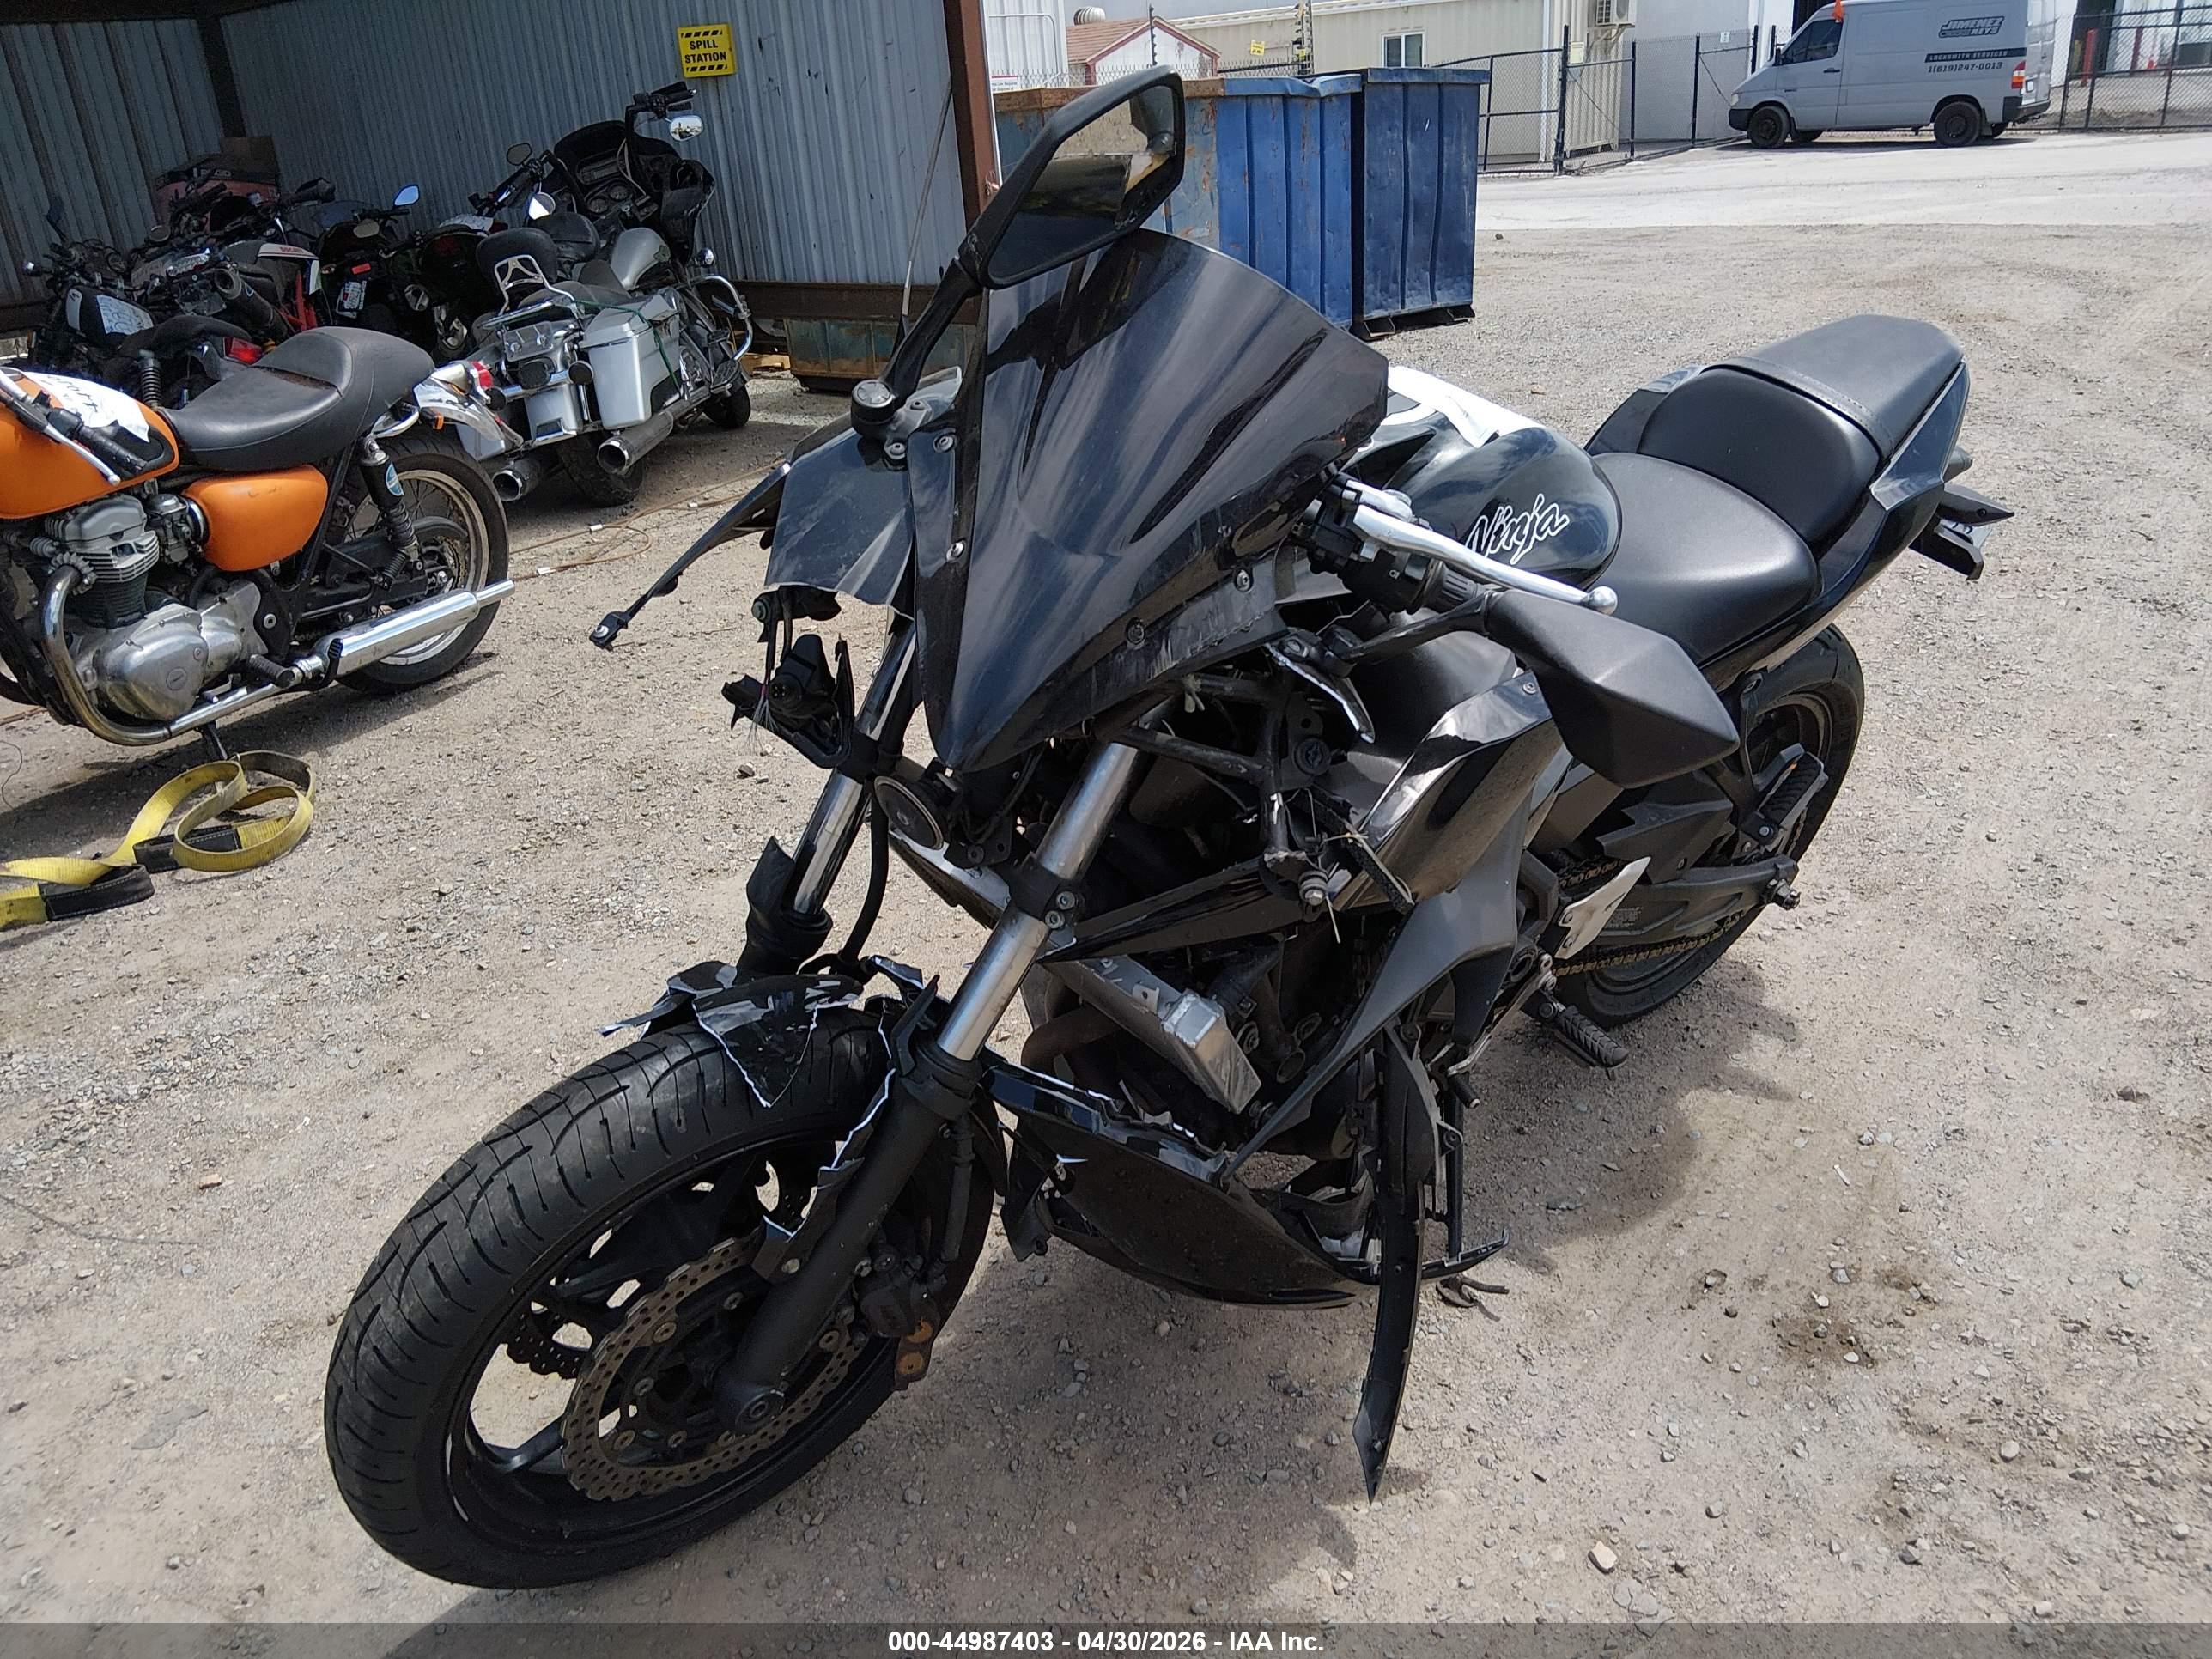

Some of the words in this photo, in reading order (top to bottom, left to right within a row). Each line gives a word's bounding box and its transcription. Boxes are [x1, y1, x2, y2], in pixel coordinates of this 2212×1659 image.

[1942, 18, 2003, 29] JIMENEZ
[690, 39, 719, 50] SPILL
[684, 52, 727, 64] STATION
[1465, 493, 1570, 565] Ninja
